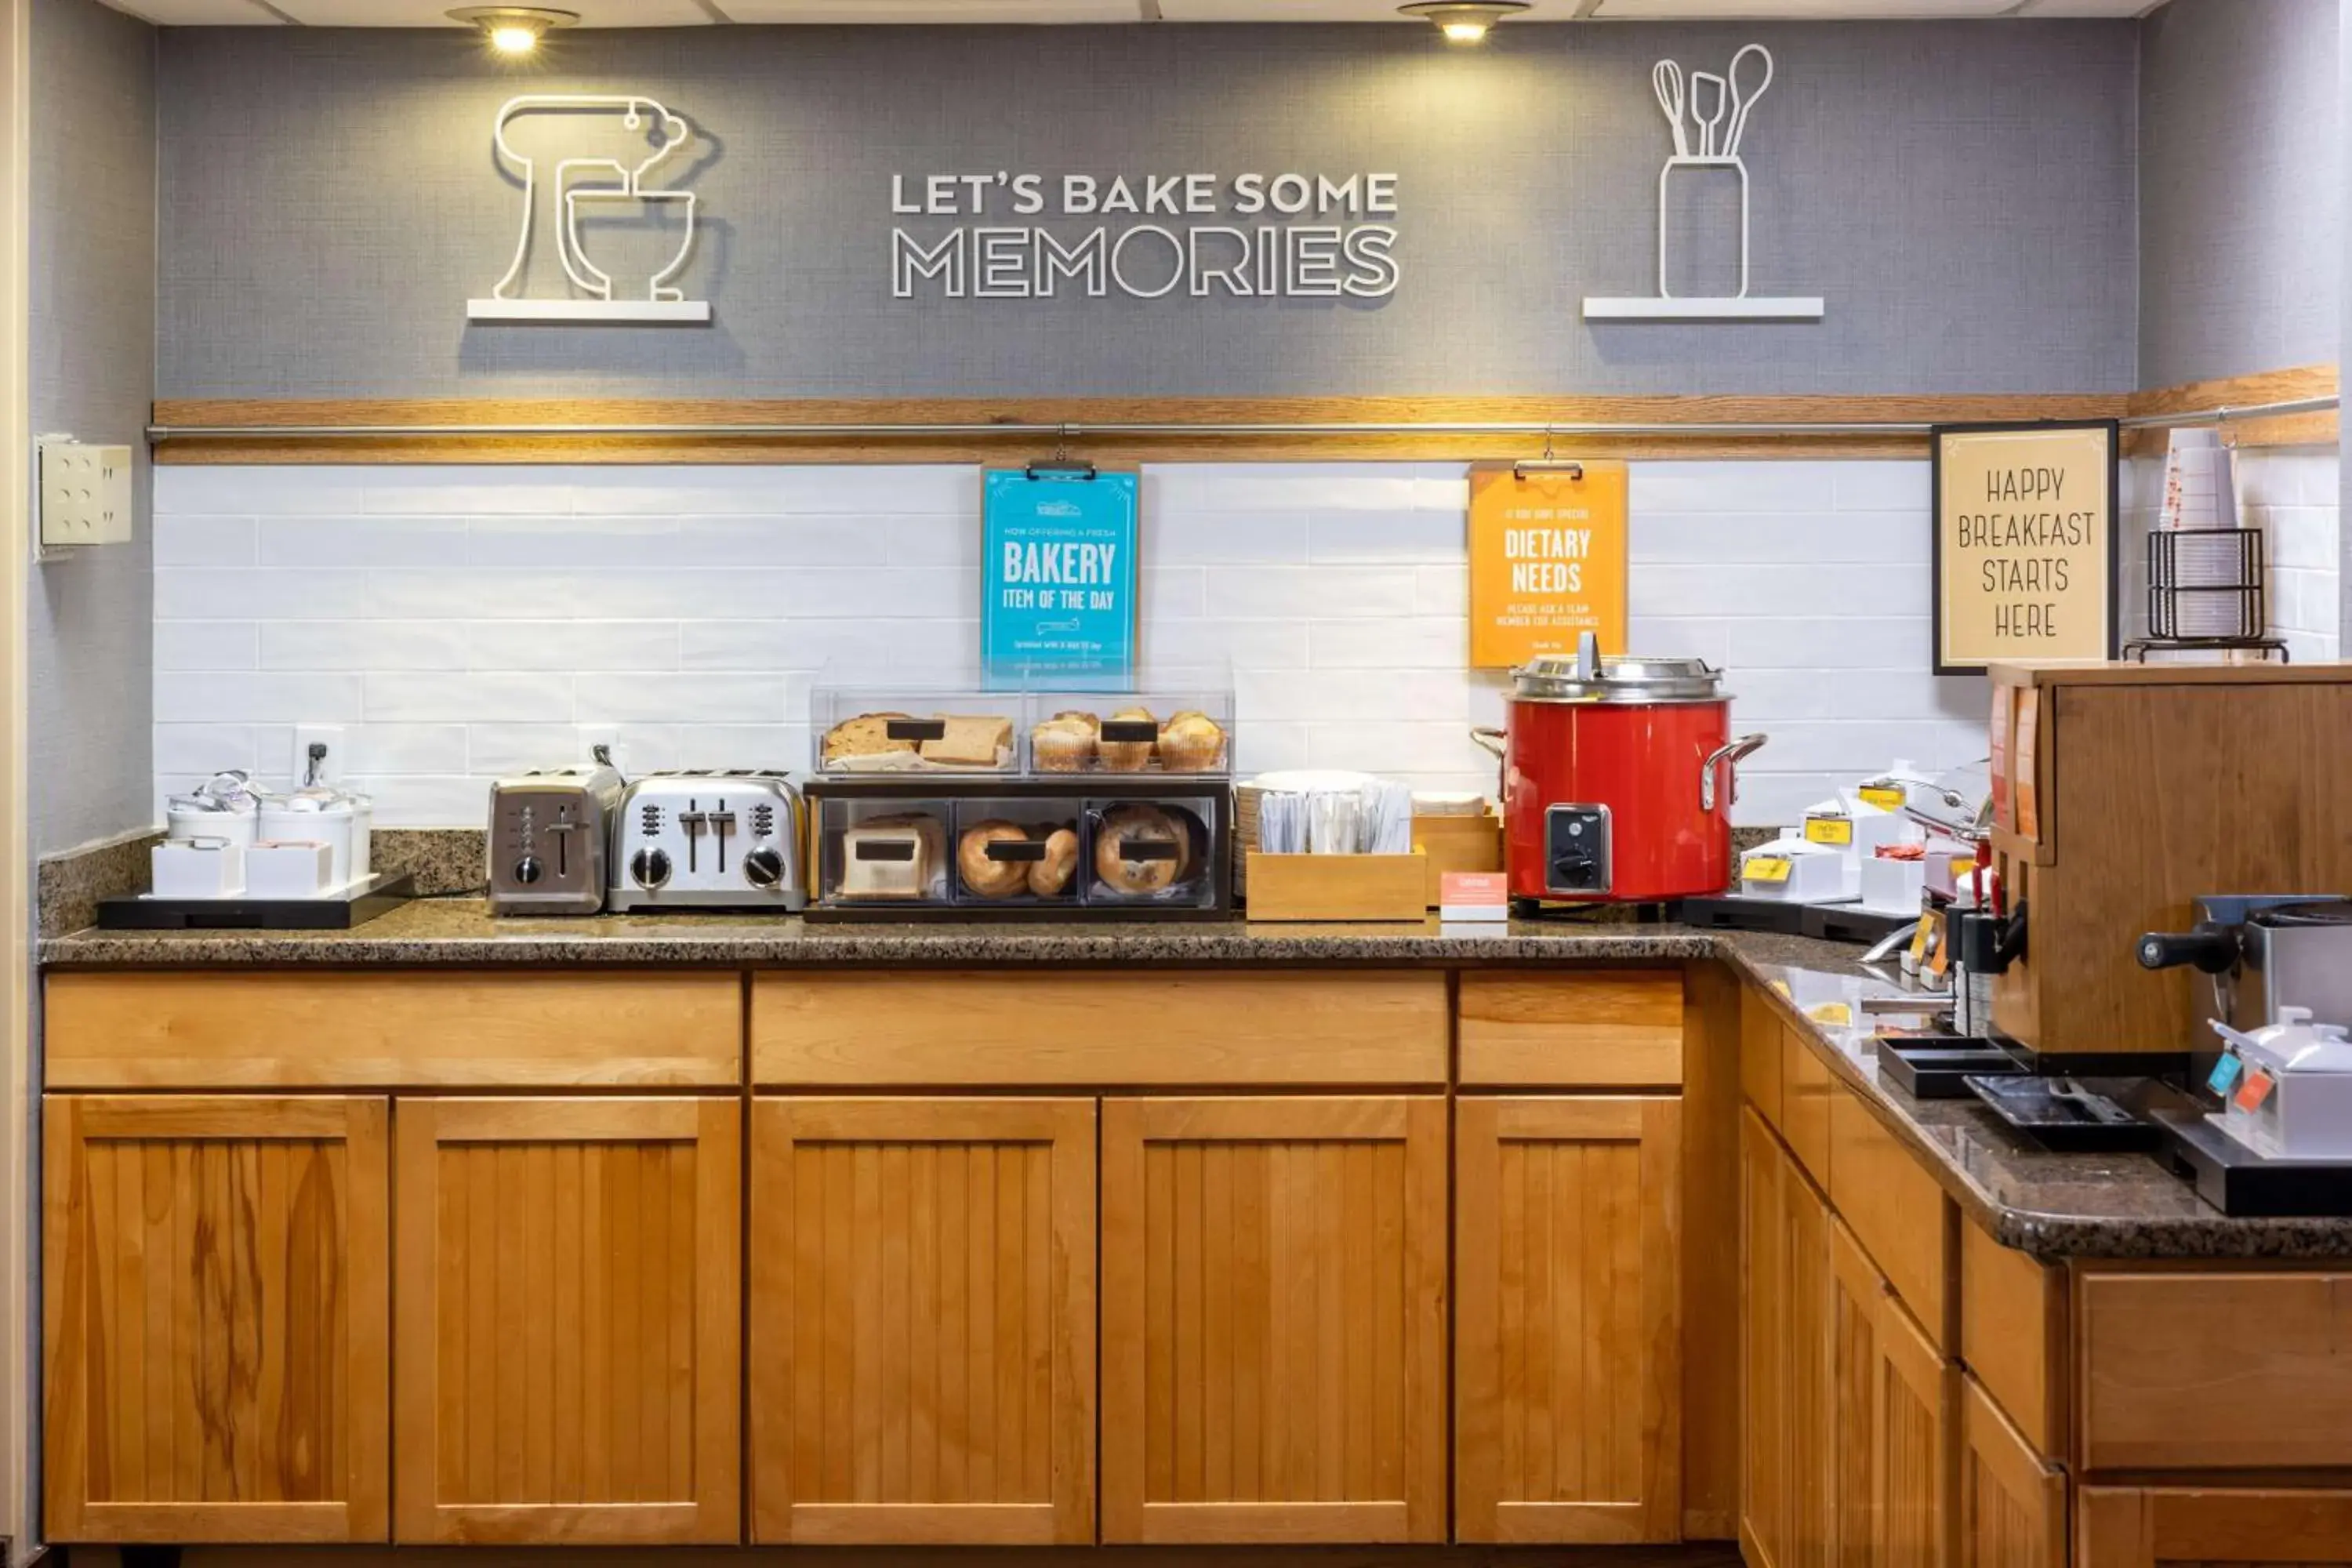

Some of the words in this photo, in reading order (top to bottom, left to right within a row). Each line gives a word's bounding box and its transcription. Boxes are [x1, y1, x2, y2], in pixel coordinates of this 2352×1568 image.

[892, 170, 1044, 214] LET'S
[1063, 174, 1217, 214] BAKE
[1234, 173, 1398, 214] SOME
[892, 224, 1400, 297] MEMORIES
[1987, 468, 2065, 503] HAPPY
[1504, 528, 1592, 559] DIETARY
[1958, 511, 2096, 548] BREAKFAST
[1004, 541, 1116, 584] BAKERY
[1512, 562, 1581, 593] NEEDS
[1982, 557, 2069, 593] STARTS
[1003, 589, 1034, 608] ITEM
[1039, 590, 1056, 608] OF
[1061, 590, 1085, 609] THE
[1090, 590, 1115, 610] DAY
[1994, 603, 2057, 637] HERE
